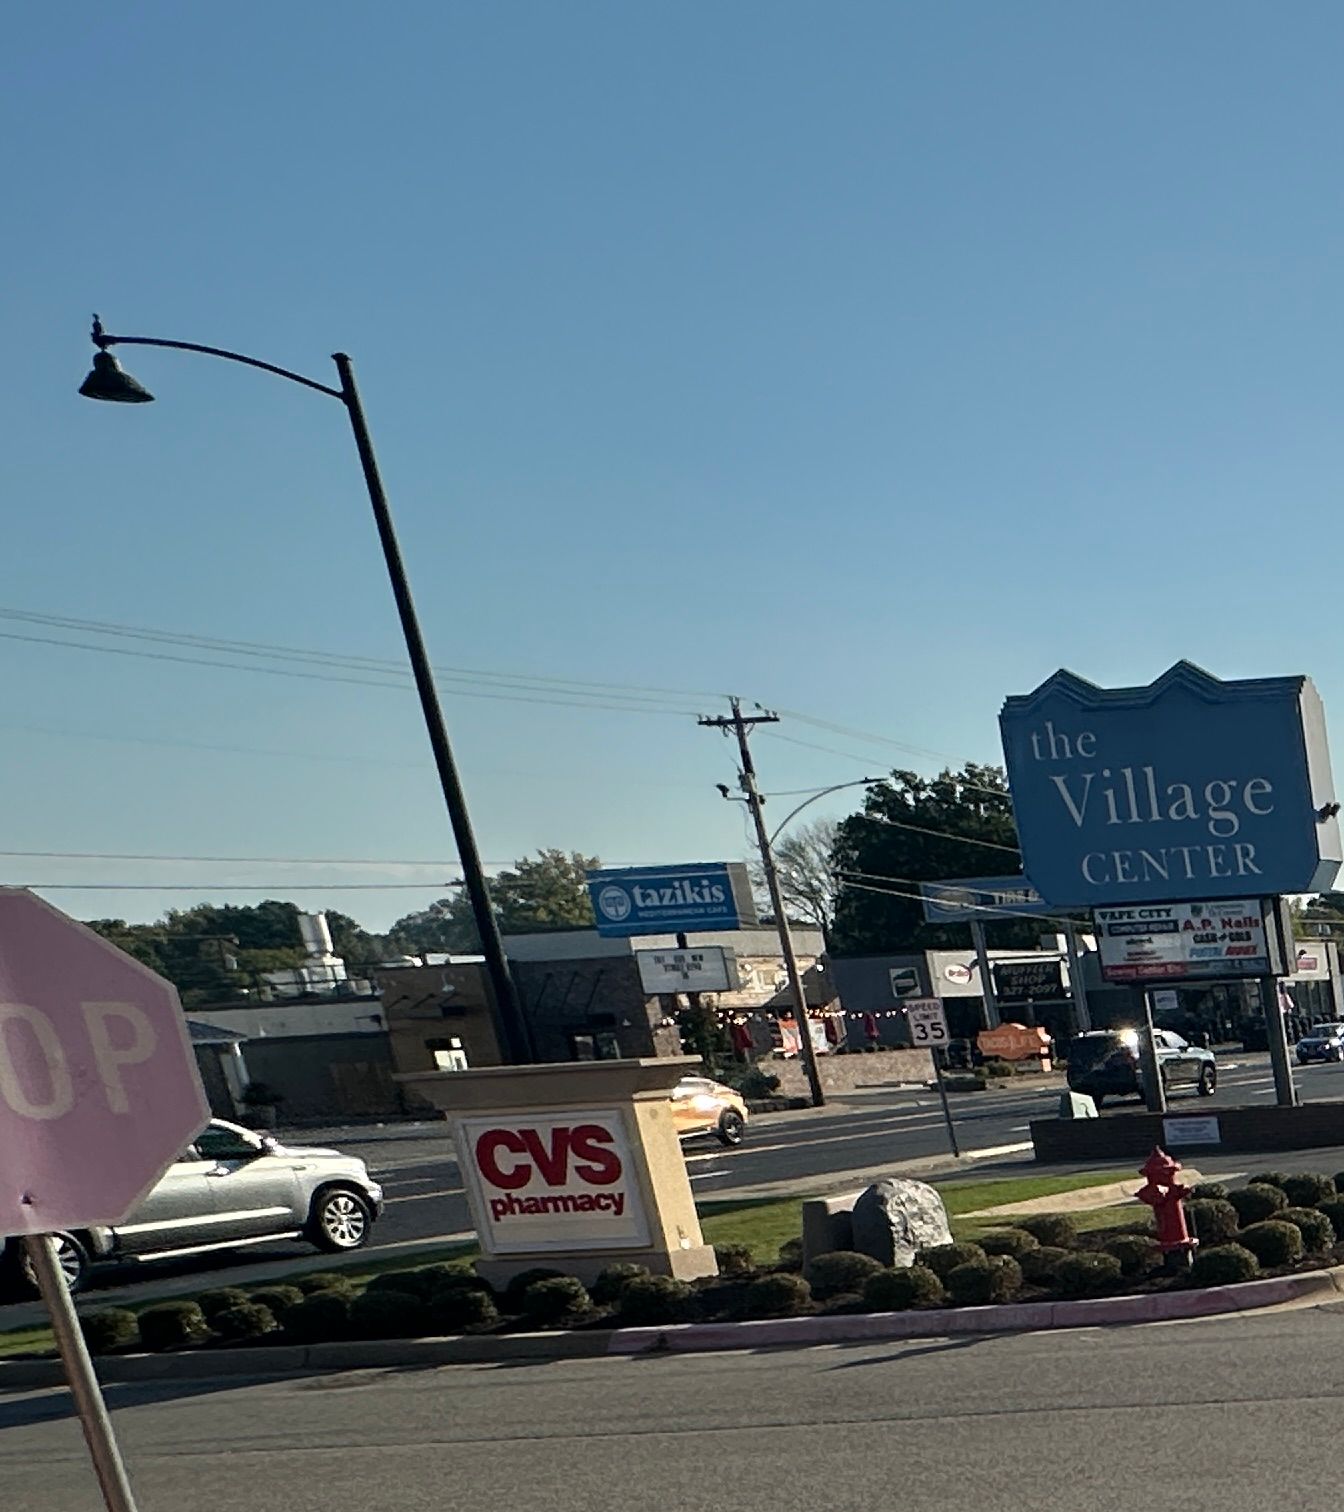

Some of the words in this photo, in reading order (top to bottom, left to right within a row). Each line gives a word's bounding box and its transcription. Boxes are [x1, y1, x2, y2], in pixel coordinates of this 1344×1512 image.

[1031, 721, 1097, 760] the
[1049, 766, 1275, 837] Village
[1081, 843, 1264, 885] CENTER
[632, 879, 726, 908] tazikis
[1138, 908, 1172, 919] CITY
[910, 1002, 940, 1012] SPEED
[913, 1012, 938, 1022] LIMIT
[914, 1022, 945, 1040] 35
[475, 1124, 622, 1190] CVS
[490, 1192, 625, 1222] pharmacy
